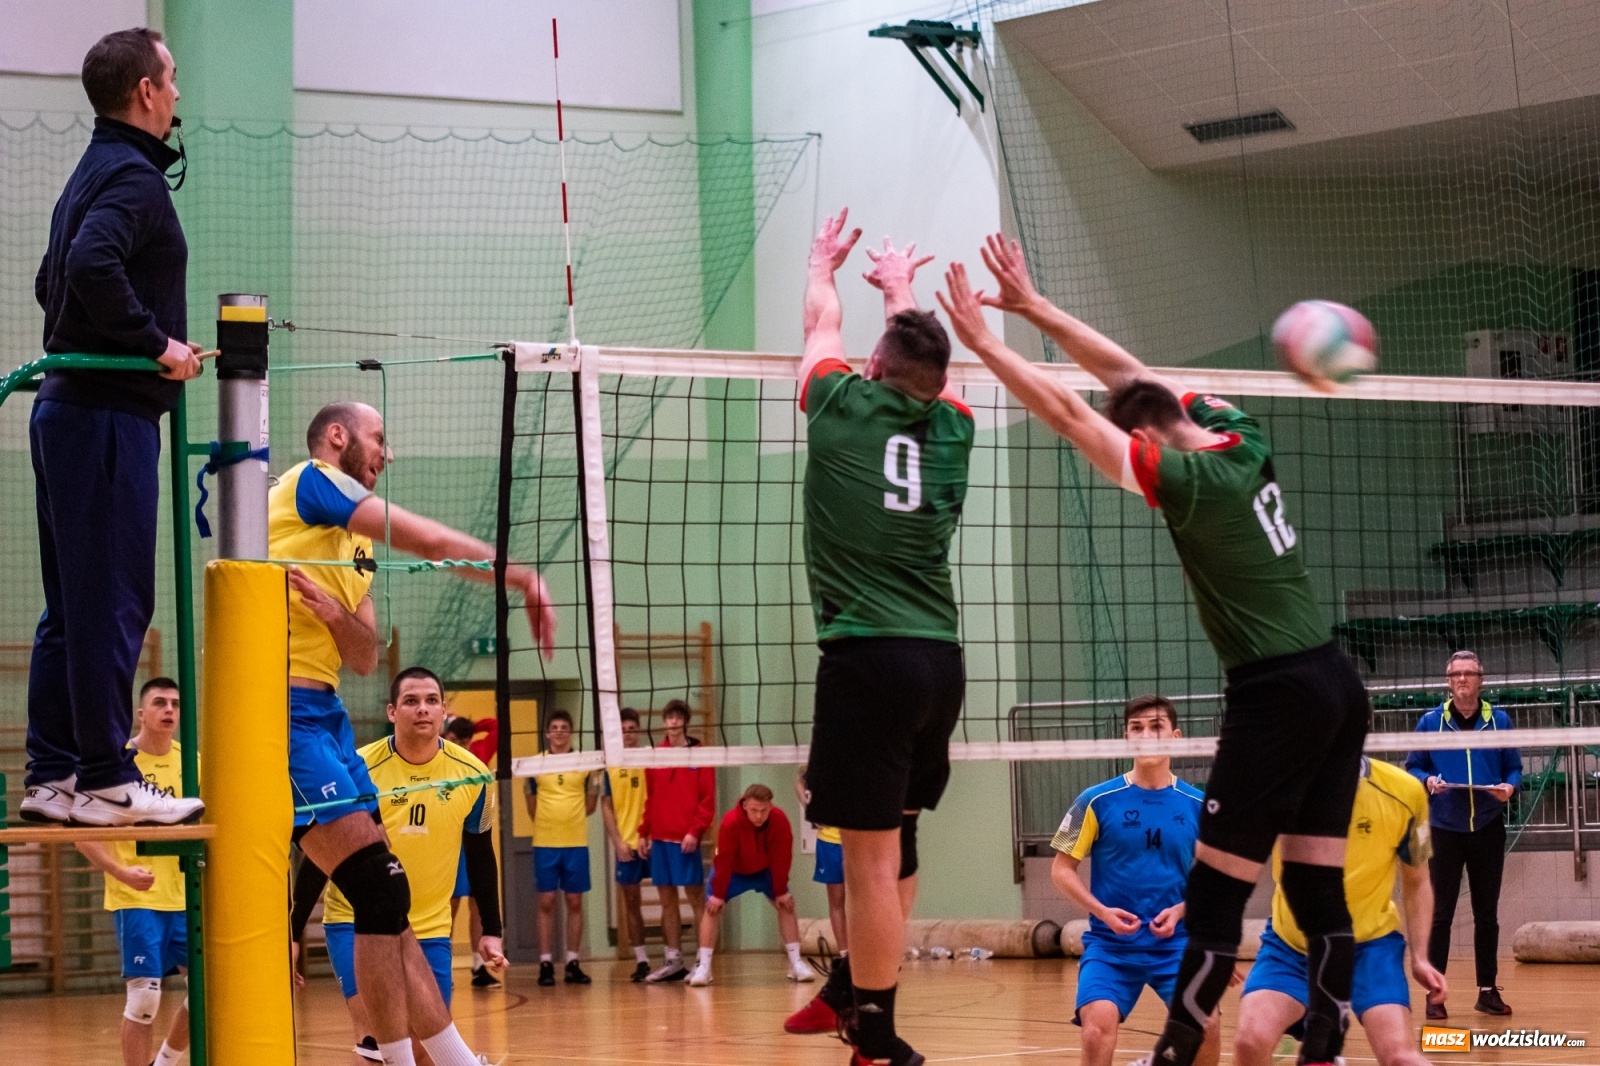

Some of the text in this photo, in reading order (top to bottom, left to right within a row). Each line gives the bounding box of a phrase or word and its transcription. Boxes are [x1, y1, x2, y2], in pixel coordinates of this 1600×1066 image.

[883, 433, 921, 512] 9
[1253, 482, 1296, 557] 12
[557, 774, 564, 786] 5
[409, 803, 426, 826] 10
[1145, 828, 1162, 850] 14
